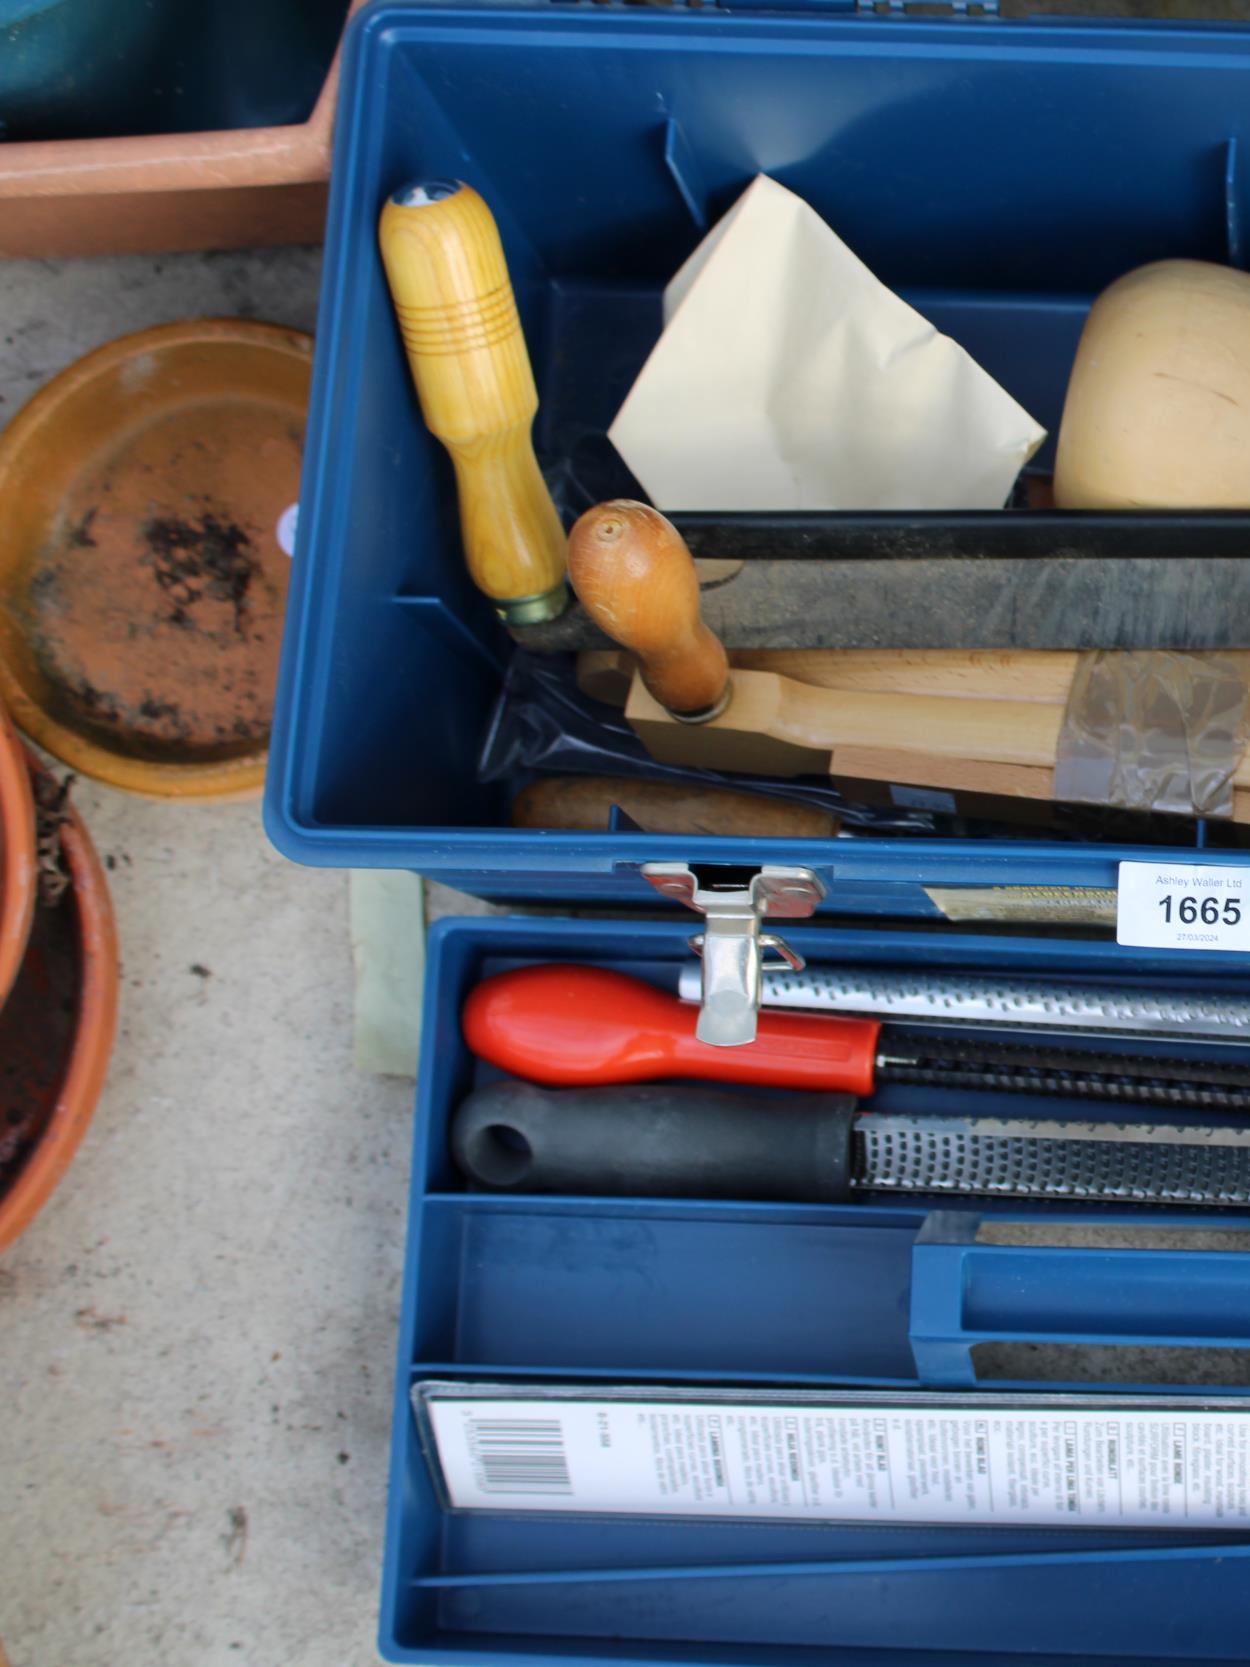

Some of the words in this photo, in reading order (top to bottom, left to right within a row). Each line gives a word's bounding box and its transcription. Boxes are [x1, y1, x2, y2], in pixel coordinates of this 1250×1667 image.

[1155, 875, 1190, 888] Ashley
[1192, 877, 1224, 888] Waller
[1226, 879, 1243, 888] Ltd
[1159, 894, 1242, 926] 1665
[1176, 933, 1219, 942] 27/03/2024
[1173, 1440, 1183, 1460] LAME
